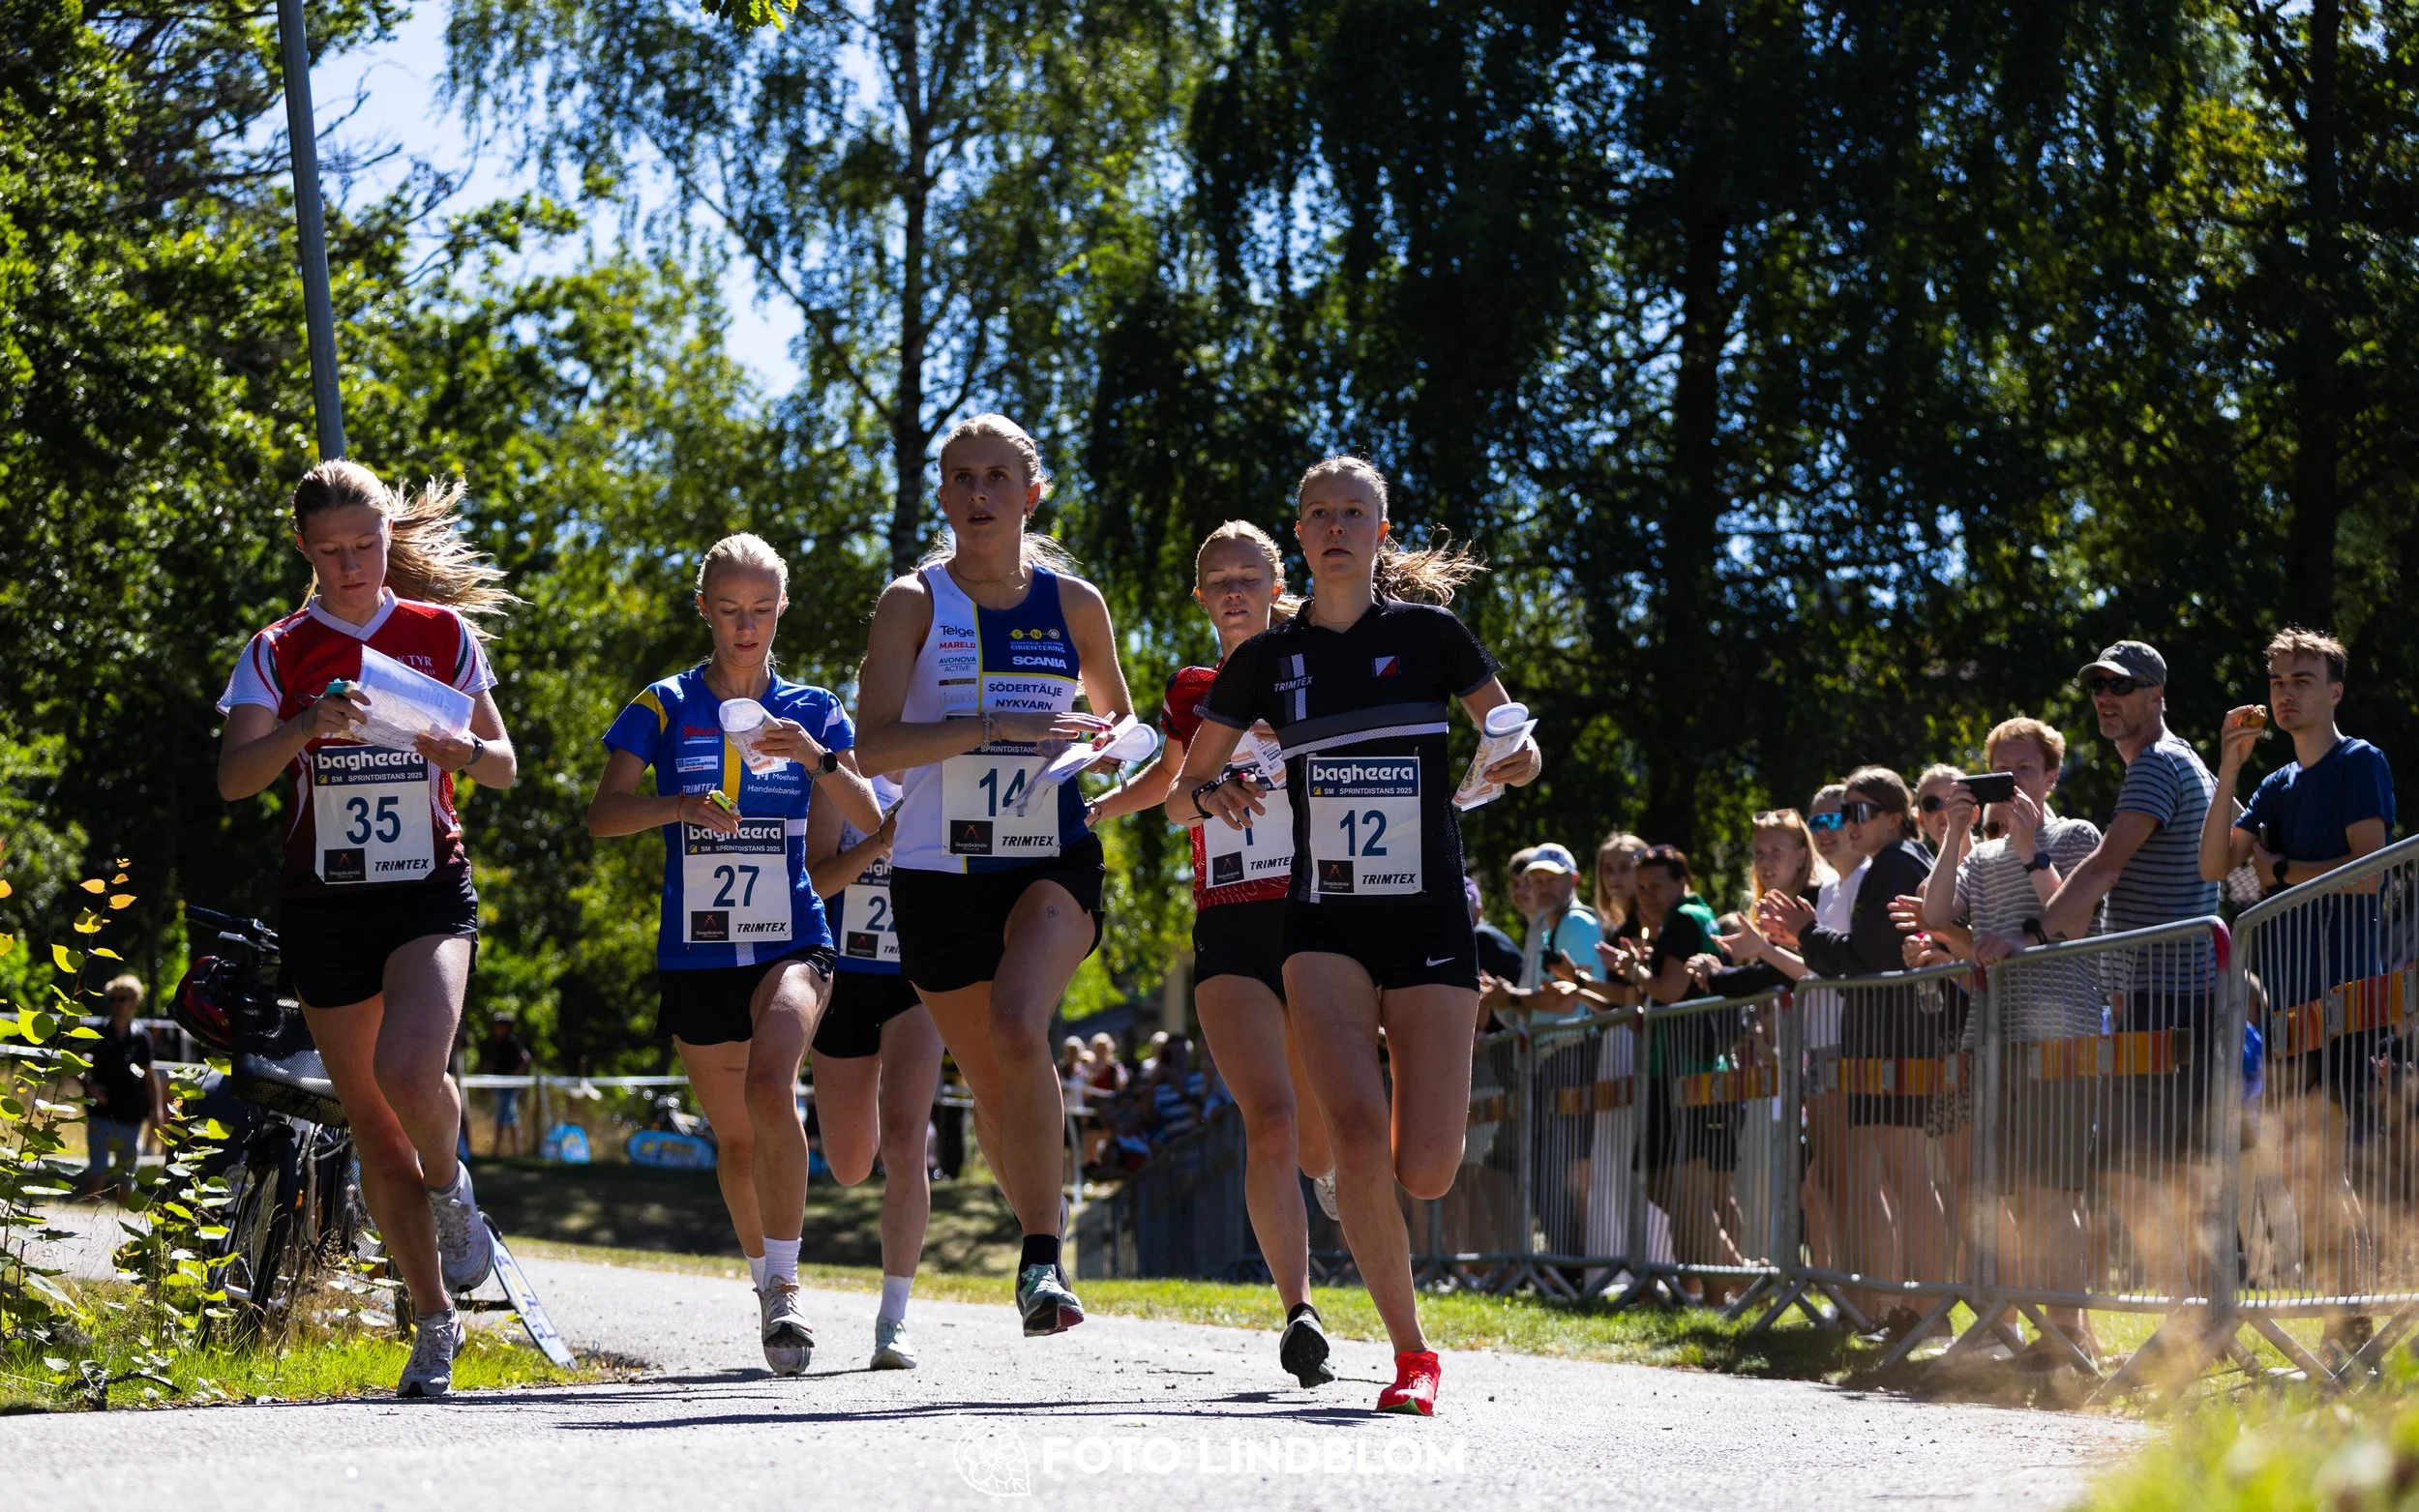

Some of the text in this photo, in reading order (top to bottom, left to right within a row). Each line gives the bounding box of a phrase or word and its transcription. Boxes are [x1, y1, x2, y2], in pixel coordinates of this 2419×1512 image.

[940, 625, 975, 638] Telge
[939, 641, 976, 650] MARELD
[1010, 644, 1065, 653] ORIENTERING
[407, 655, 433, 667] TYR
[1012, 656, 1067, 669] SCANIA
[988, 681, 1063, 697] SÖDERTÄLJE
[1274, 675, 1313, 693] TRIMTEX
[996, 698, 1053, 711] NYKVARN
[317, 751, 424, 771] bagheera
[347, 772, 405, 783] SPRINTDISTANS
[1312, 764, 1414, 784] bagheera
[682, 782, 717, 794] TRIMTEX
[747, 785, 801, 796] Handelsbanken
[979, 768, 1026, 817] 14
[345, 796, 402, 845] 35
[1339, 809, 1388, 857] 12
[1001, 836, 1054, 846] TRIMTEX
[374, 859, 430, 872] TRIMTEX
[1250, 856, 1292, 871] TRIMTE
[1361, 873, 1417, 884] TRIMTEX
[712, 865, 761, 906] 27
[865, 895, 897, 933] 2
[736, 922, 788, 934] TRIMTEX
